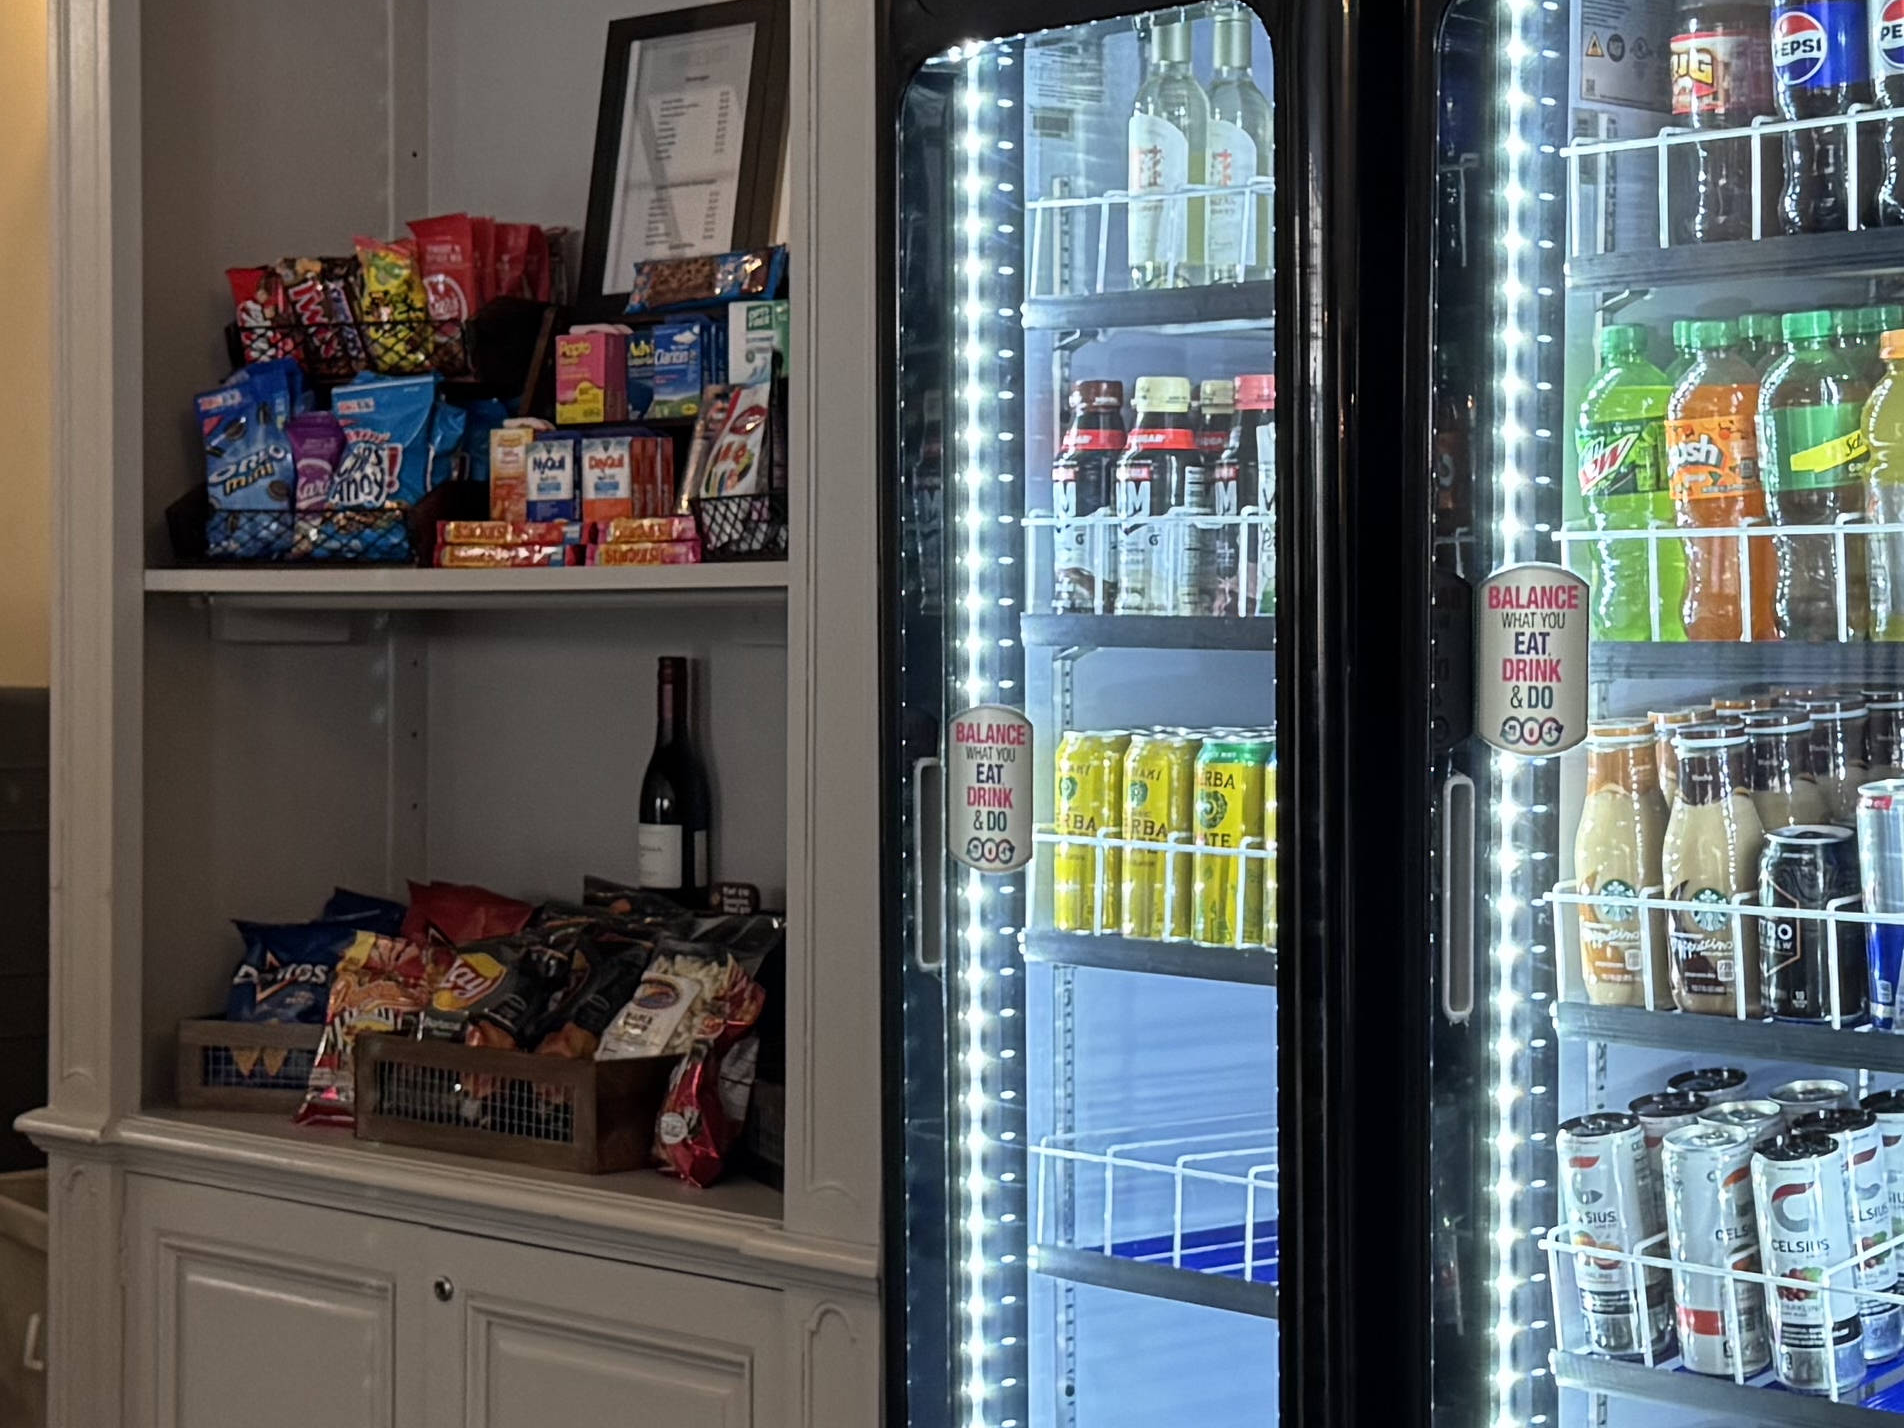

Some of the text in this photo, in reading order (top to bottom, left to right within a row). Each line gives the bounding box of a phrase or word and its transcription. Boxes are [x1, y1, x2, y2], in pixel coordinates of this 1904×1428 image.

[1672, 47, 1714, 85] UG
[533, 455, 566, 475] NyQuil
[588, 454, 624, 475] DayQuil
[1488, 585, 1579, 610] BALANCE
[1502, 612, 1566, 629] WHAT YOU
[1502, 658, 1562, 683] DRINK
[1510, 684, 1554, 709] & DO
[956, 721, 1026, 746] BALANCE
[966, 746, 1016, 763] WHAT YOU
[967, 786, 1013, 810] DRINK
[973, 810, 1008, 832] & DO
[1715, 1225, 1750, 1242] CELS
[1771, 1239, 1830, 1253] CELSIUS
